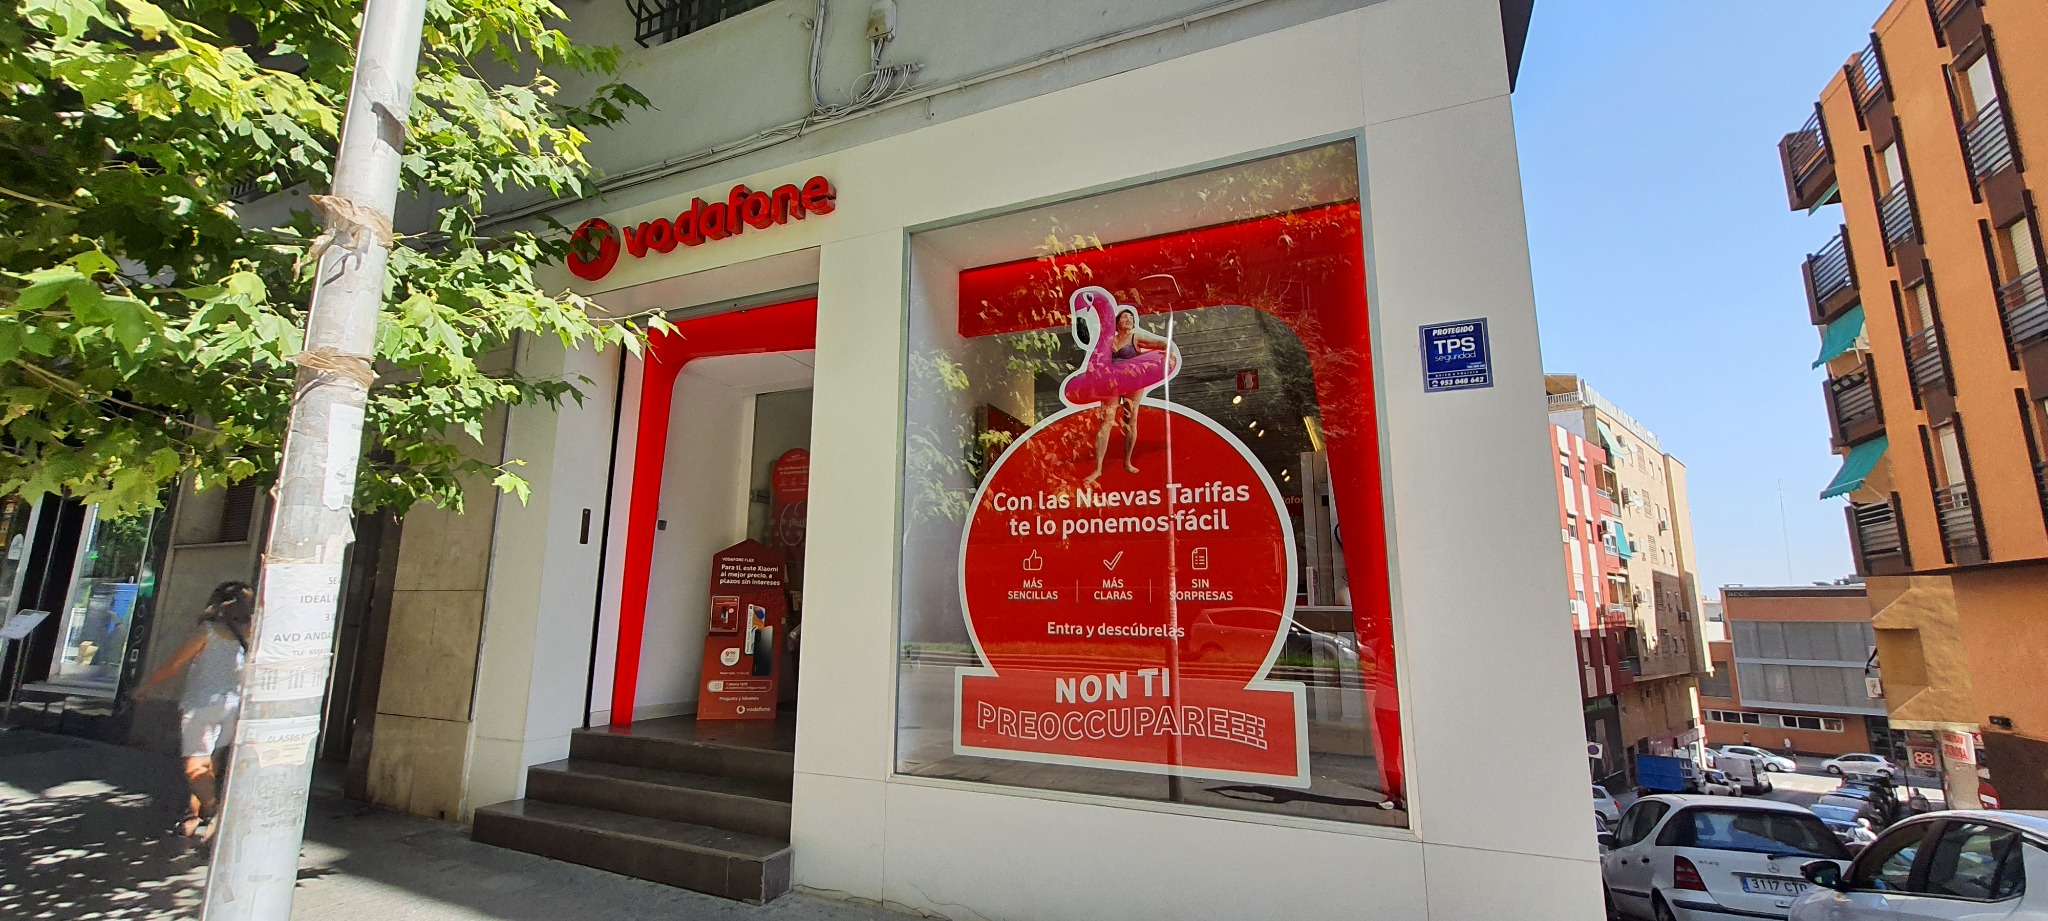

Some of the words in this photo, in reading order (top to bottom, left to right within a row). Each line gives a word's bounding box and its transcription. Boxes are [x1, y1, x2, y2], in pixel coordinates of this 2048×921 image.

[622, 175, 837, 259] vodafone
[1432, 325, 1474, 336] PROTEGIDO
[1434, 337, 1476, 354] TPS
[1435, 350, 1476, 363] seguridad
[993, 492, 1032, 512] Con
[1039, 491, 1070, 510] las
[1077, 488, 1161, 508] Nuevas
[1166, 481, 1250, 504] Tarifas
[1010, 518, 1030, 536] te
[1036, 516, 1056, 535] lo
[1063, 514, 1170, 539] ponemos
[1174, 508, 1230, 532] fácil
[1023, 577, 1043, 588] MÁS
[1102, 577, 1124, 588] MÁS
[1191, 579, 1210, 588] SIN
[300, 595, 331, 604] IDEAL
[1007, 590, 1058, 600] SENCILLAS
[1094, 590, 1133, 600] CLARAS
[1169, 591, 1234, 601] SORPRESAS
[1048, 622, 1083, 635] Entra
[1086, 625, 1094, 638] y
[1098, 622, 1186, 638] descúbrelas
[273, 633, 301, 643] AVD
[1055, 671, 1128, 704] NON
[1138, 668, 1170, 697] TI
[268, 734, 300, 743] CLASES
[1751, 879, 1780, 890] 3117
